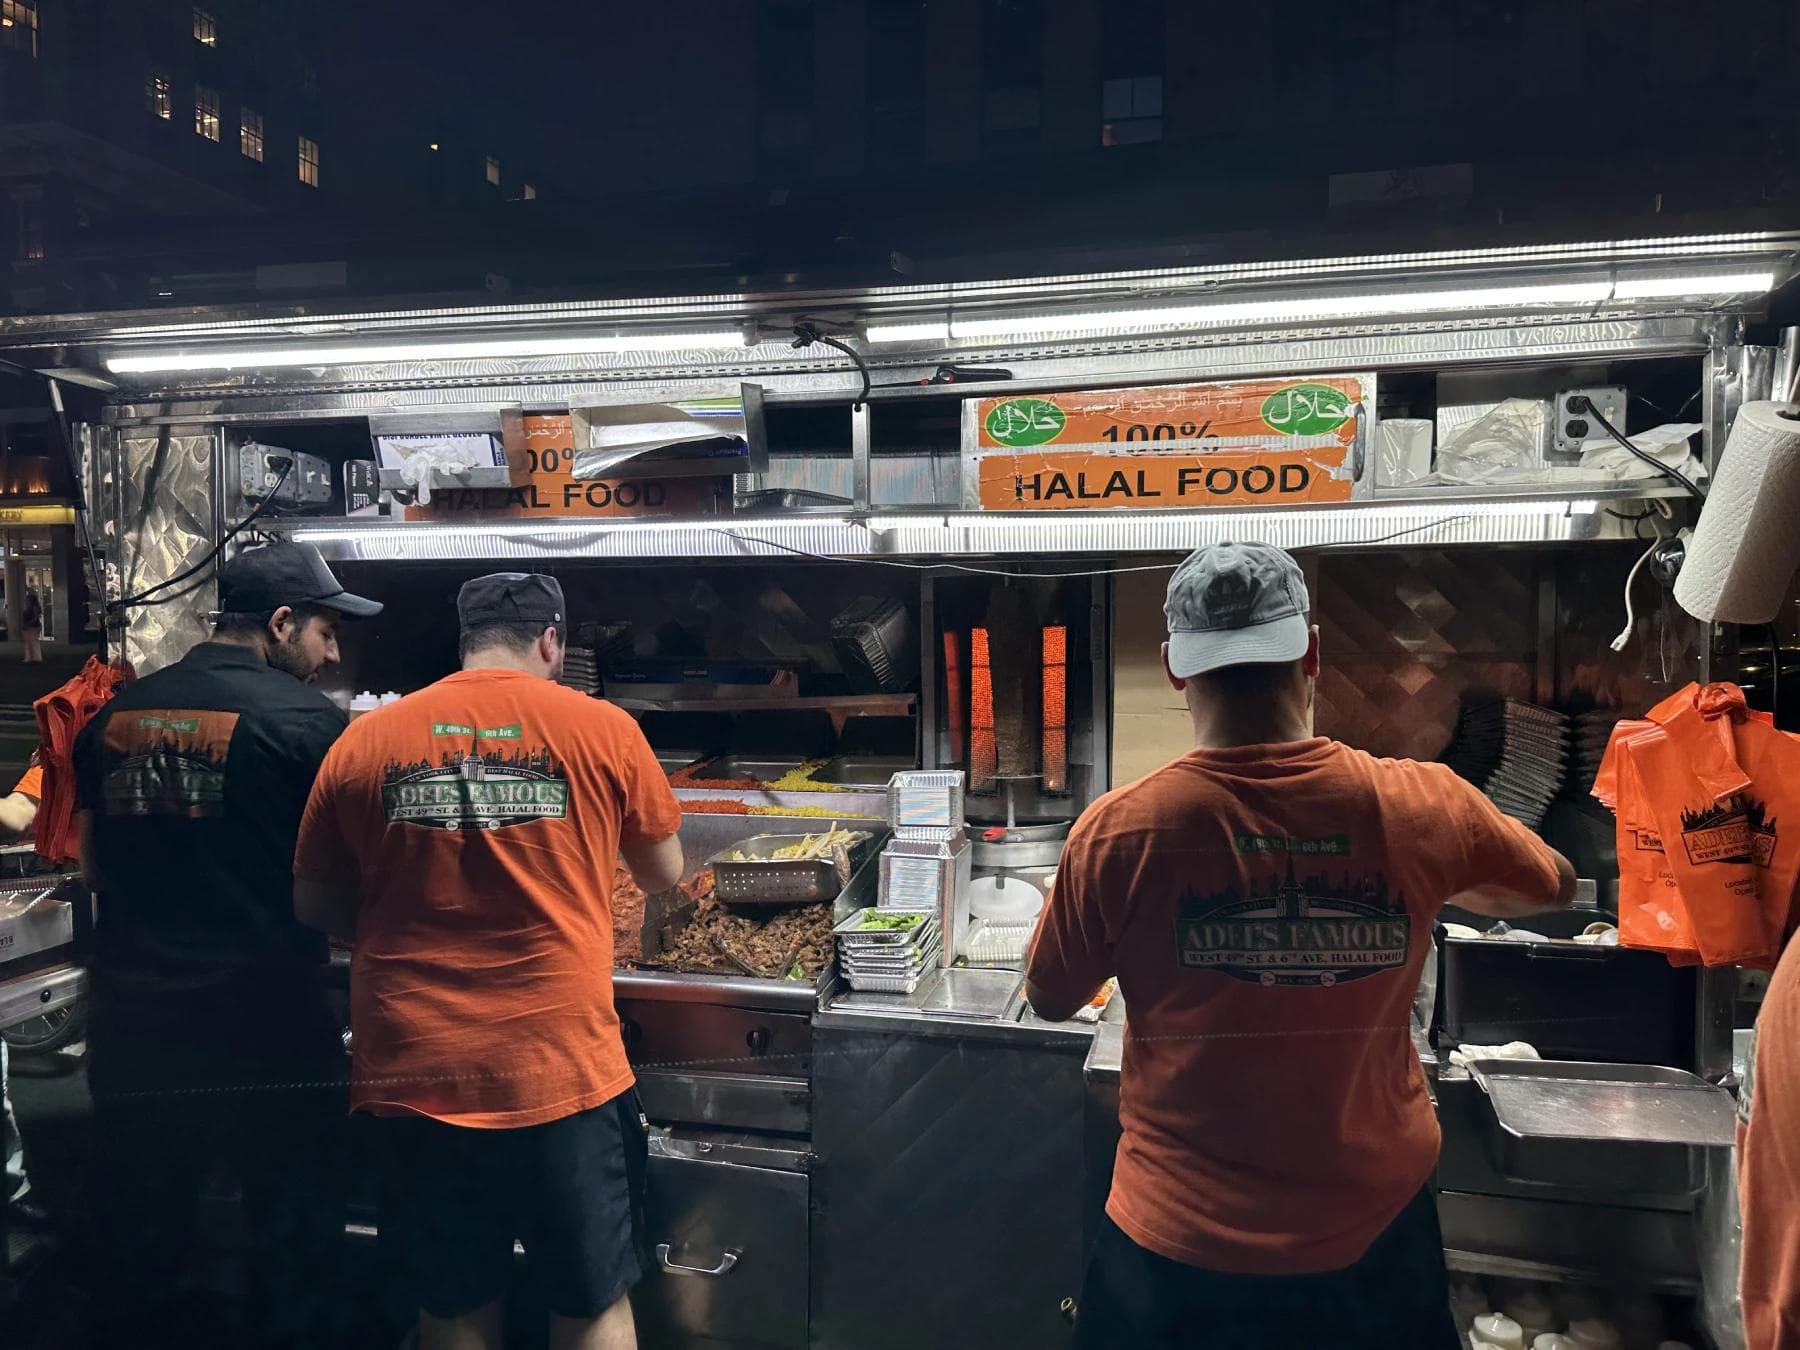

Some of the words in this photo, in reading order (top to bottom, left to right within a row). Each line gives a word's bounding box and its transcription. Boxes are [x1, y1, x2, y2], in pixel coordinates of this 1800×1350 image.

[563, 480, 667, 508] FOOD
[1015, 470, 1161, 500] HALAL
[1178, 464, 1310, 496] FOOD
[470, 783, 563, 803] FAMOUS
[497, 805, 529, 814] HALAL
[1289, 920, 1406, 949] FAMOUS
[1267, 952, 1276, 963] &
[1331, 951, 1371, 963] HALAL
[1372, 950, 1403, 962] FOOD
